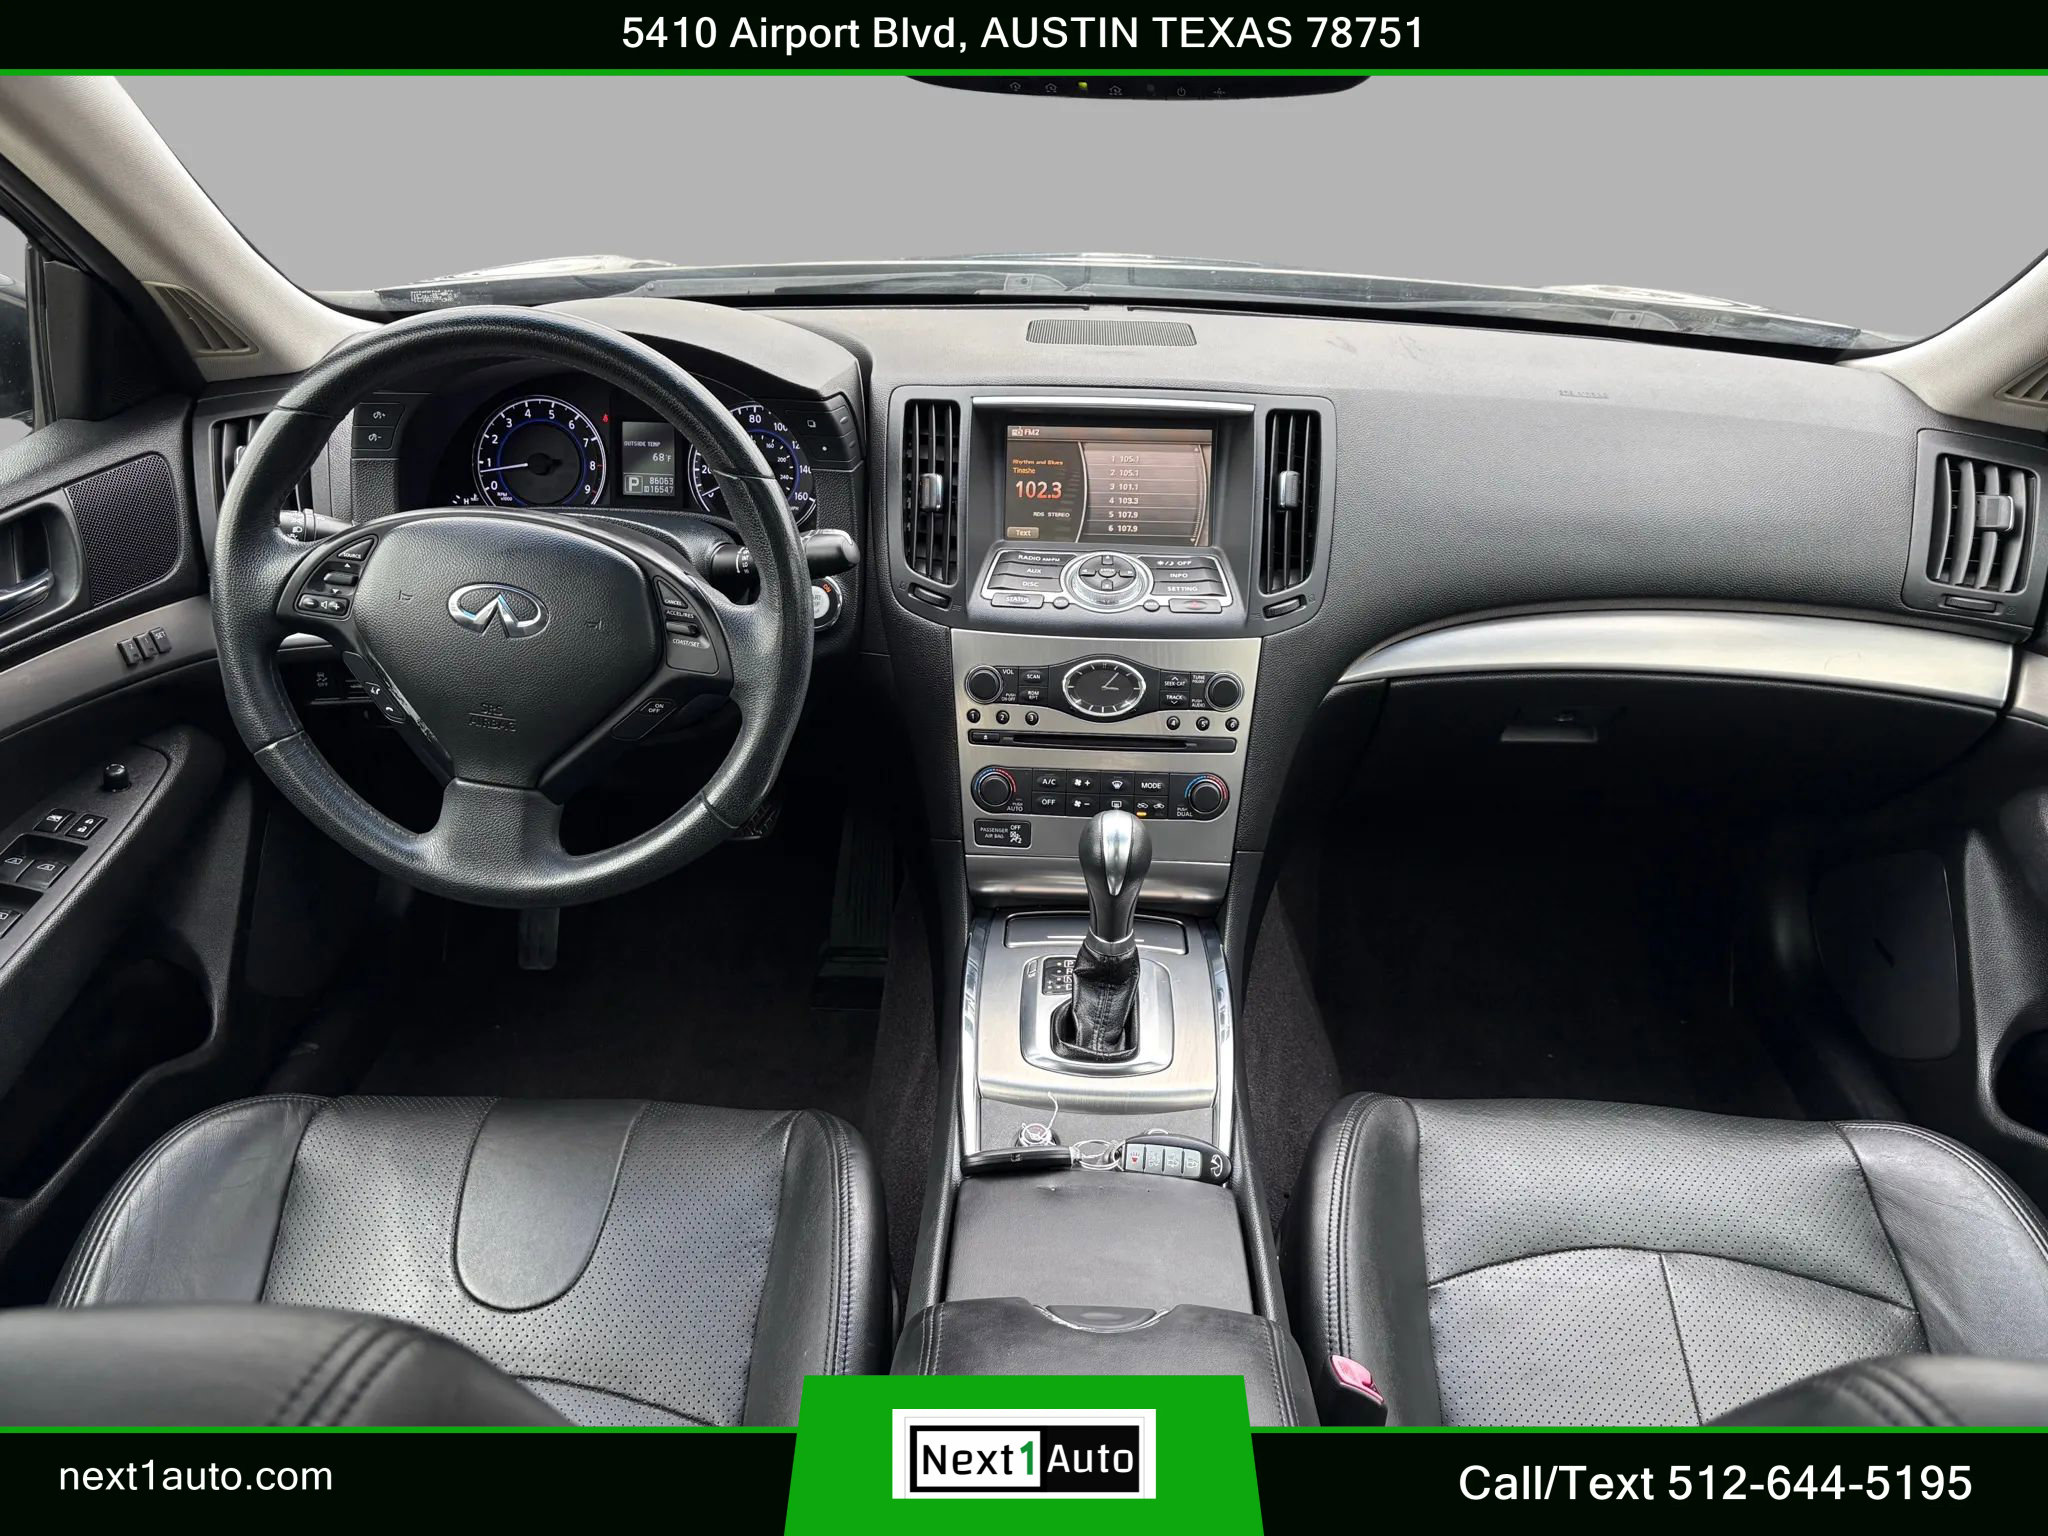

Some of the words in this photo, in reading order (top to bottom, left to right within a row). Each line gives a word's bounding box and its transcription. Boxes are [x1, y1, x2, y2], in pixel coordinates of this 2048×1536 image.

[524, 409, 532, 418] 4
[549, 410, 556, 420] 5
[506, 418, 512, 428] 3
[749, 414, 762, 424] 80
[568, 420, 575, 430] 6
[492, 434, 498, 444] 2
[583, 438, 589, 448] 7
[792, 440, 800, 450] 12
[487, 458, 491, 468] 1
[590, 460, 596, 470] 8
[490, 480, 498, 490] 0
[628, 476, 640, 492] P
[650, 476, 674, 486] 86063
[584, 484, 590, 494] 9
[1016, 480, 1062, 498] 102.3
[794, 492, 808, 501] 160
[1018, 554, 1041, 562] RADIO
[824, 584, 832, 592] ON
[666, 610, 694, 618] ACCEL/RES
[155, 632, 166, 640] SET
[672, 638, 700, 648] COAST/SET
[1042, 778, 1056, 786] A/C
[1142, 782, 1162, 790] MODE
[1042, 798, 1055, 806] OFF
